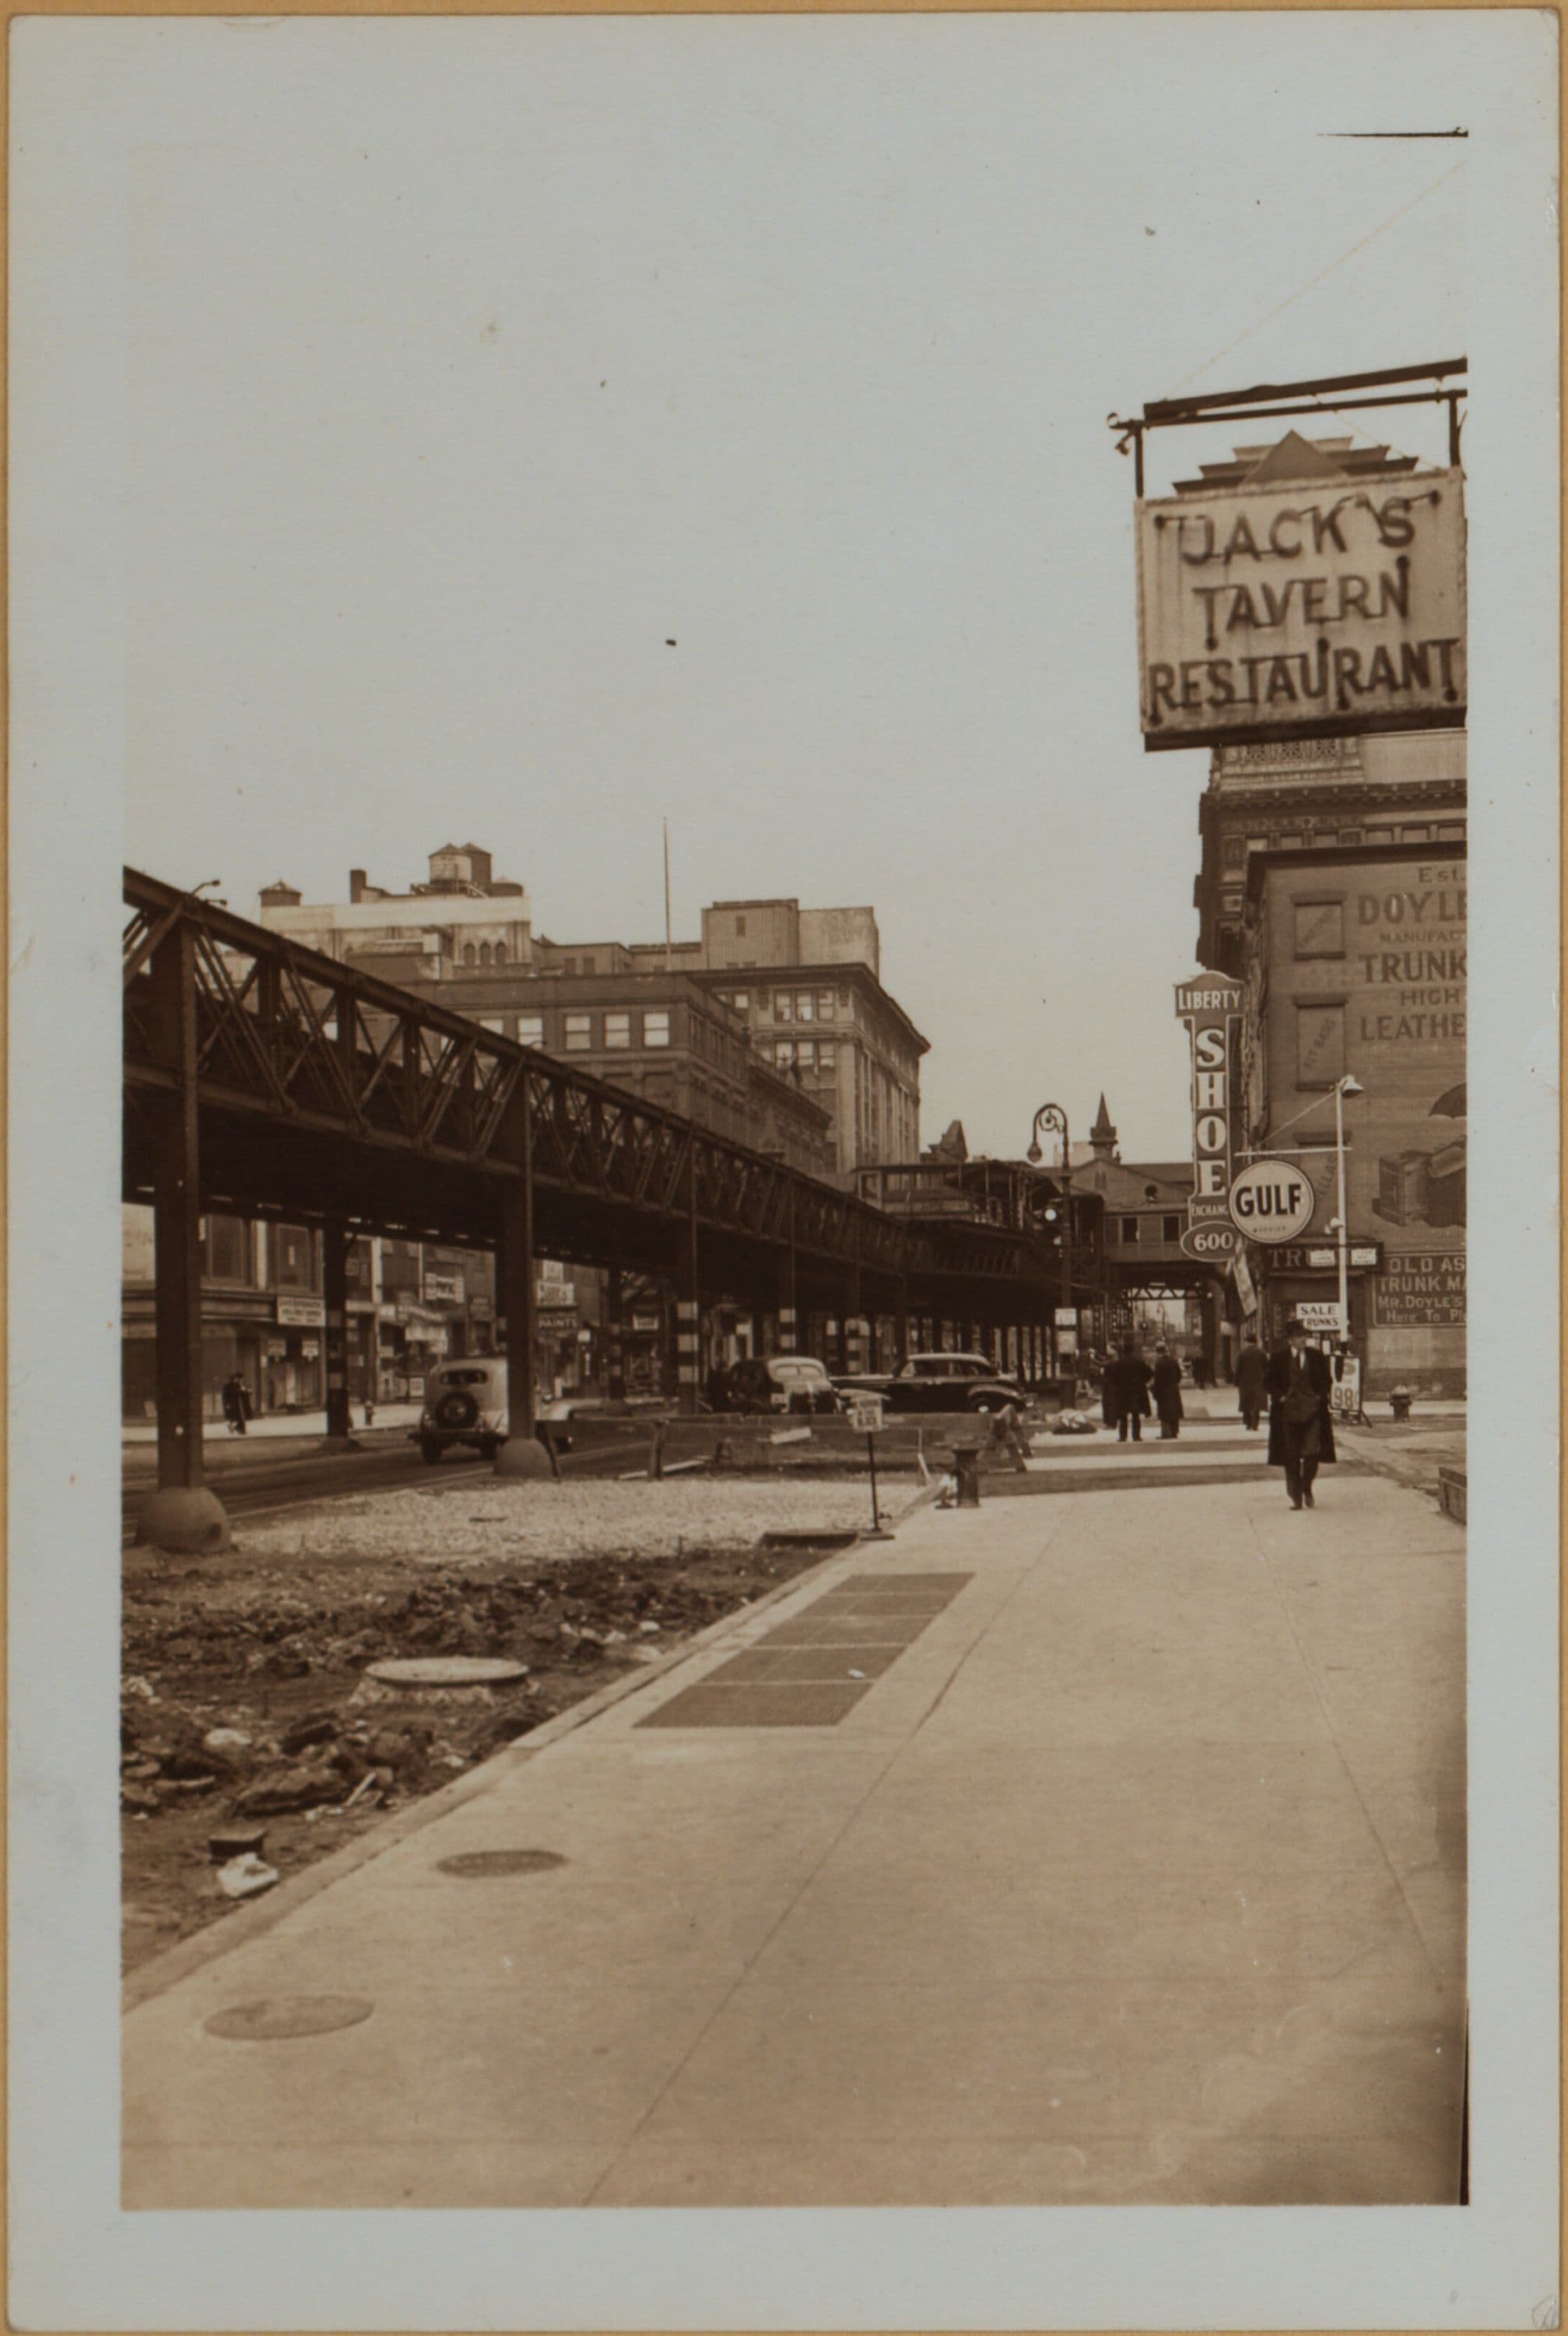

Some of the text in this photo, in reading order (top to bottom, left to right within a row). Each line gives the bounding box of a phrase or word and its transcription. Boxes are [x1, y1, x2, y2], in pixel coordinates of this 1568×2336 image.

[1178, 494, 1415, 565] JACK'S
[1191, 568, 1410, 634] TAVERN
[1148, 638, 1460, 708] RESTAURANT
[1177, 988, 1241, 1010] LIBERTY
[1401, 987, 1460, 1006] HIGH
[1359, 1013, 1466, 1041] LEATHE
[1195, 1028, 1226, 1197] SHOE
[1235, 1183, 1302, 1217] GULF
[1194, 1231, 1233, 1252] 600
[1388, 1257, 1434, 1273] OLD
[1379, 1277, 1440, 1293] TRUNK
[1300, 1305, 1337, 1316] SALE
